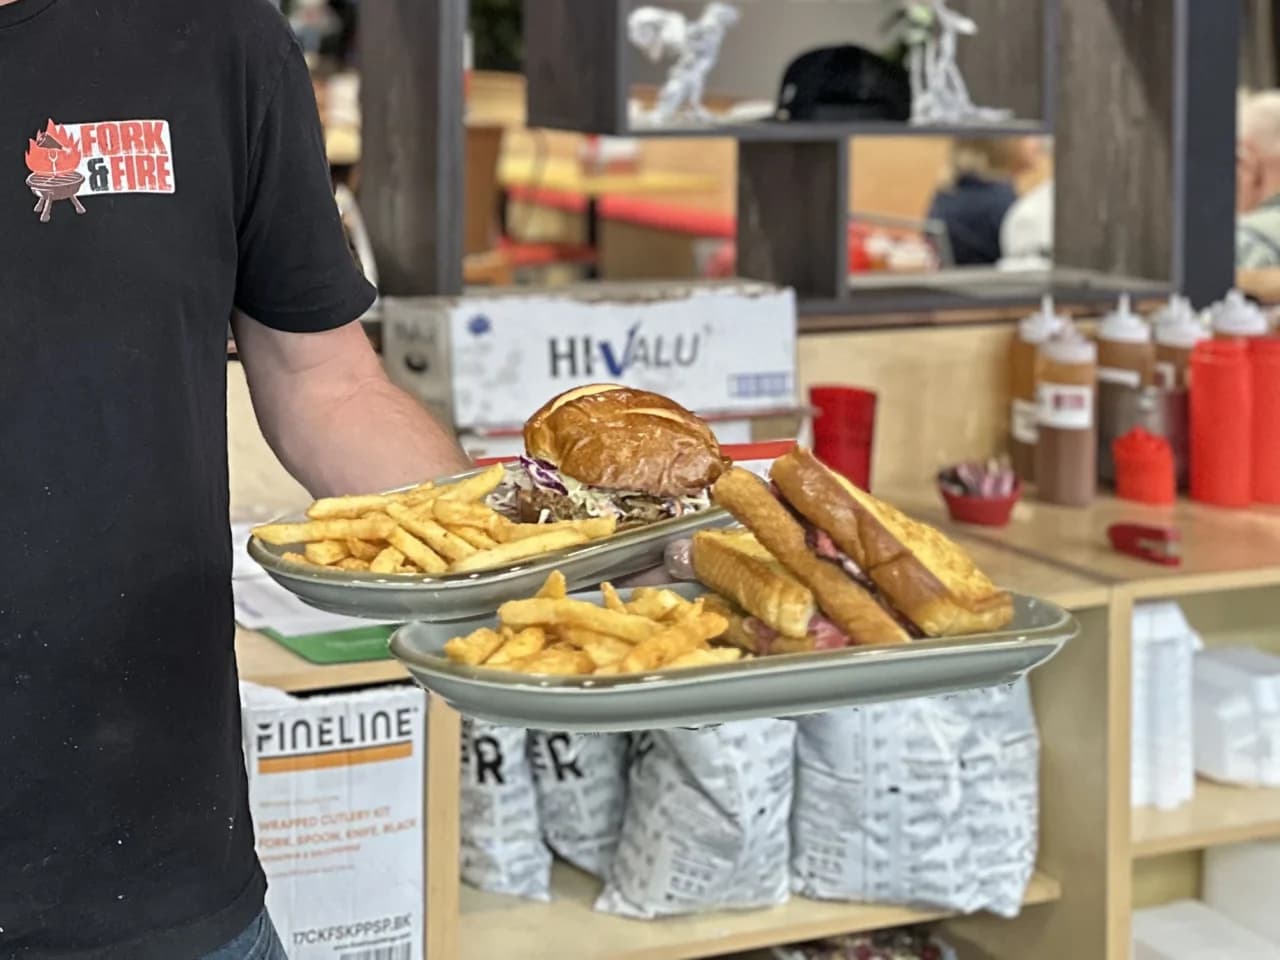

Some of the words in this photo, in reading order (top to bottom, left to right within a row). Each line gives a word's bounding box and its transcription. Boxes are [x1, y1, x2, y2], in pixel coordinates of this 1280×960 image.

[80, 122, 168, 156] FORK
[87, 157, 109, 191] &
[111, 156, 172, 191] FIRE
[257, 707, 413, 753] FINELINE
